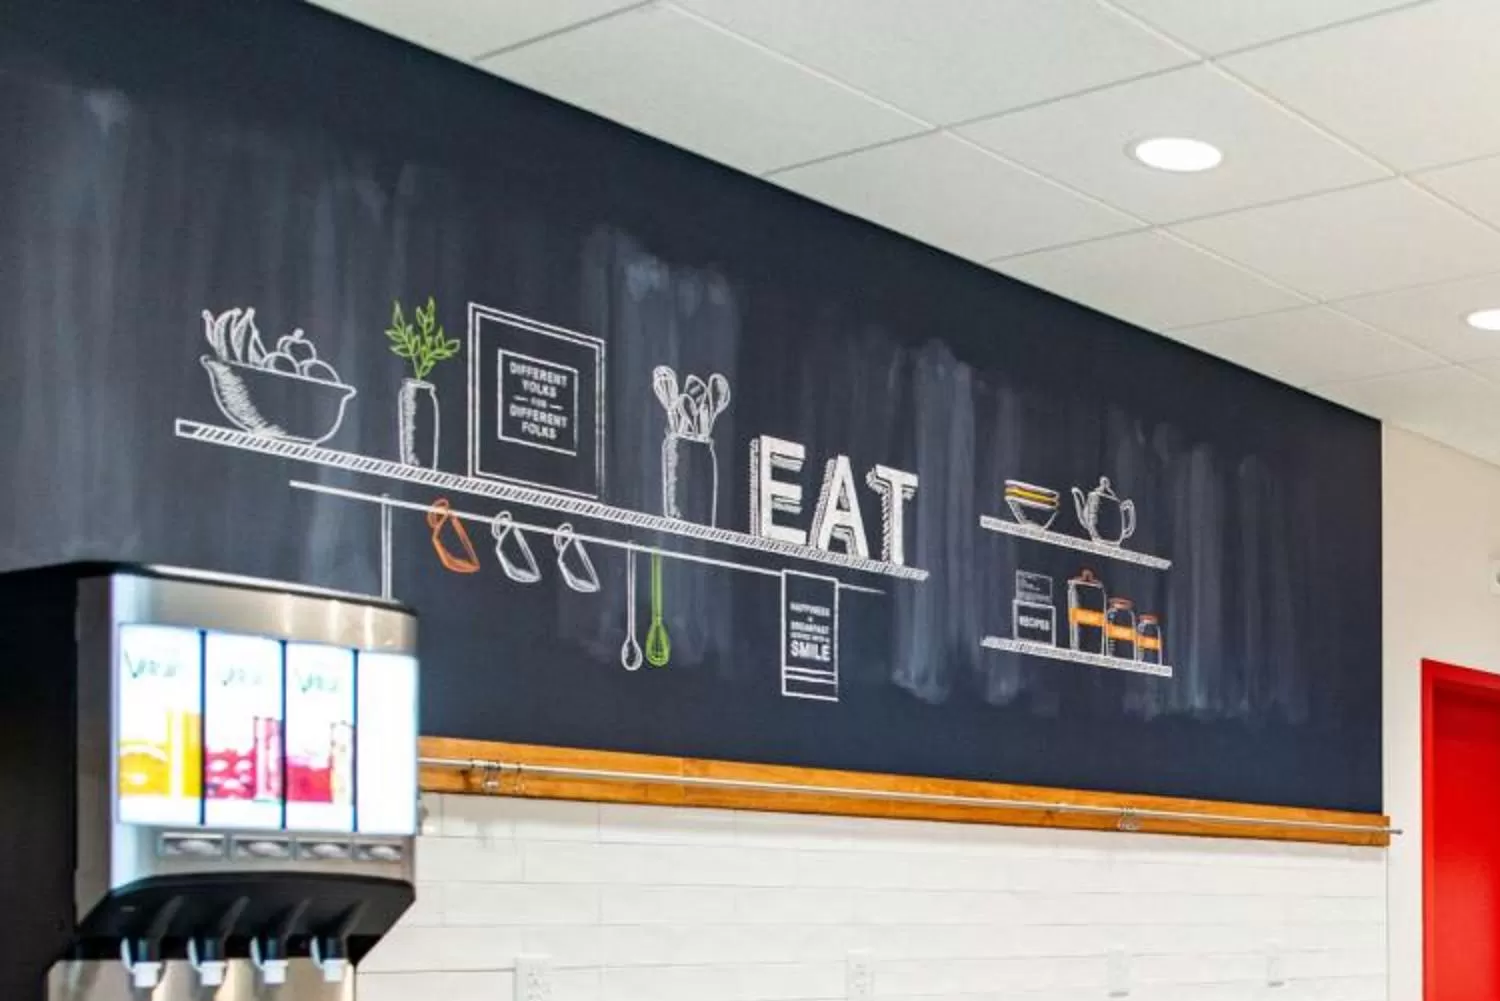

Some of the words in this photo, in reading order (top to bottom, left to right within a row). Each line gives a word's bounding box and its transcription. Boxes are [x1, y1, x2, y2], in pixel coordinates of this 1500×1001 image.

[510, 361, 567, 388] DIFFERENT
[509, 403, 568, 428] DIFFERENT
[522, 421, 557, 440] FOLKS
[750, 435, 919, 566] EAT
[790, 640, 830, 662] SMILE
